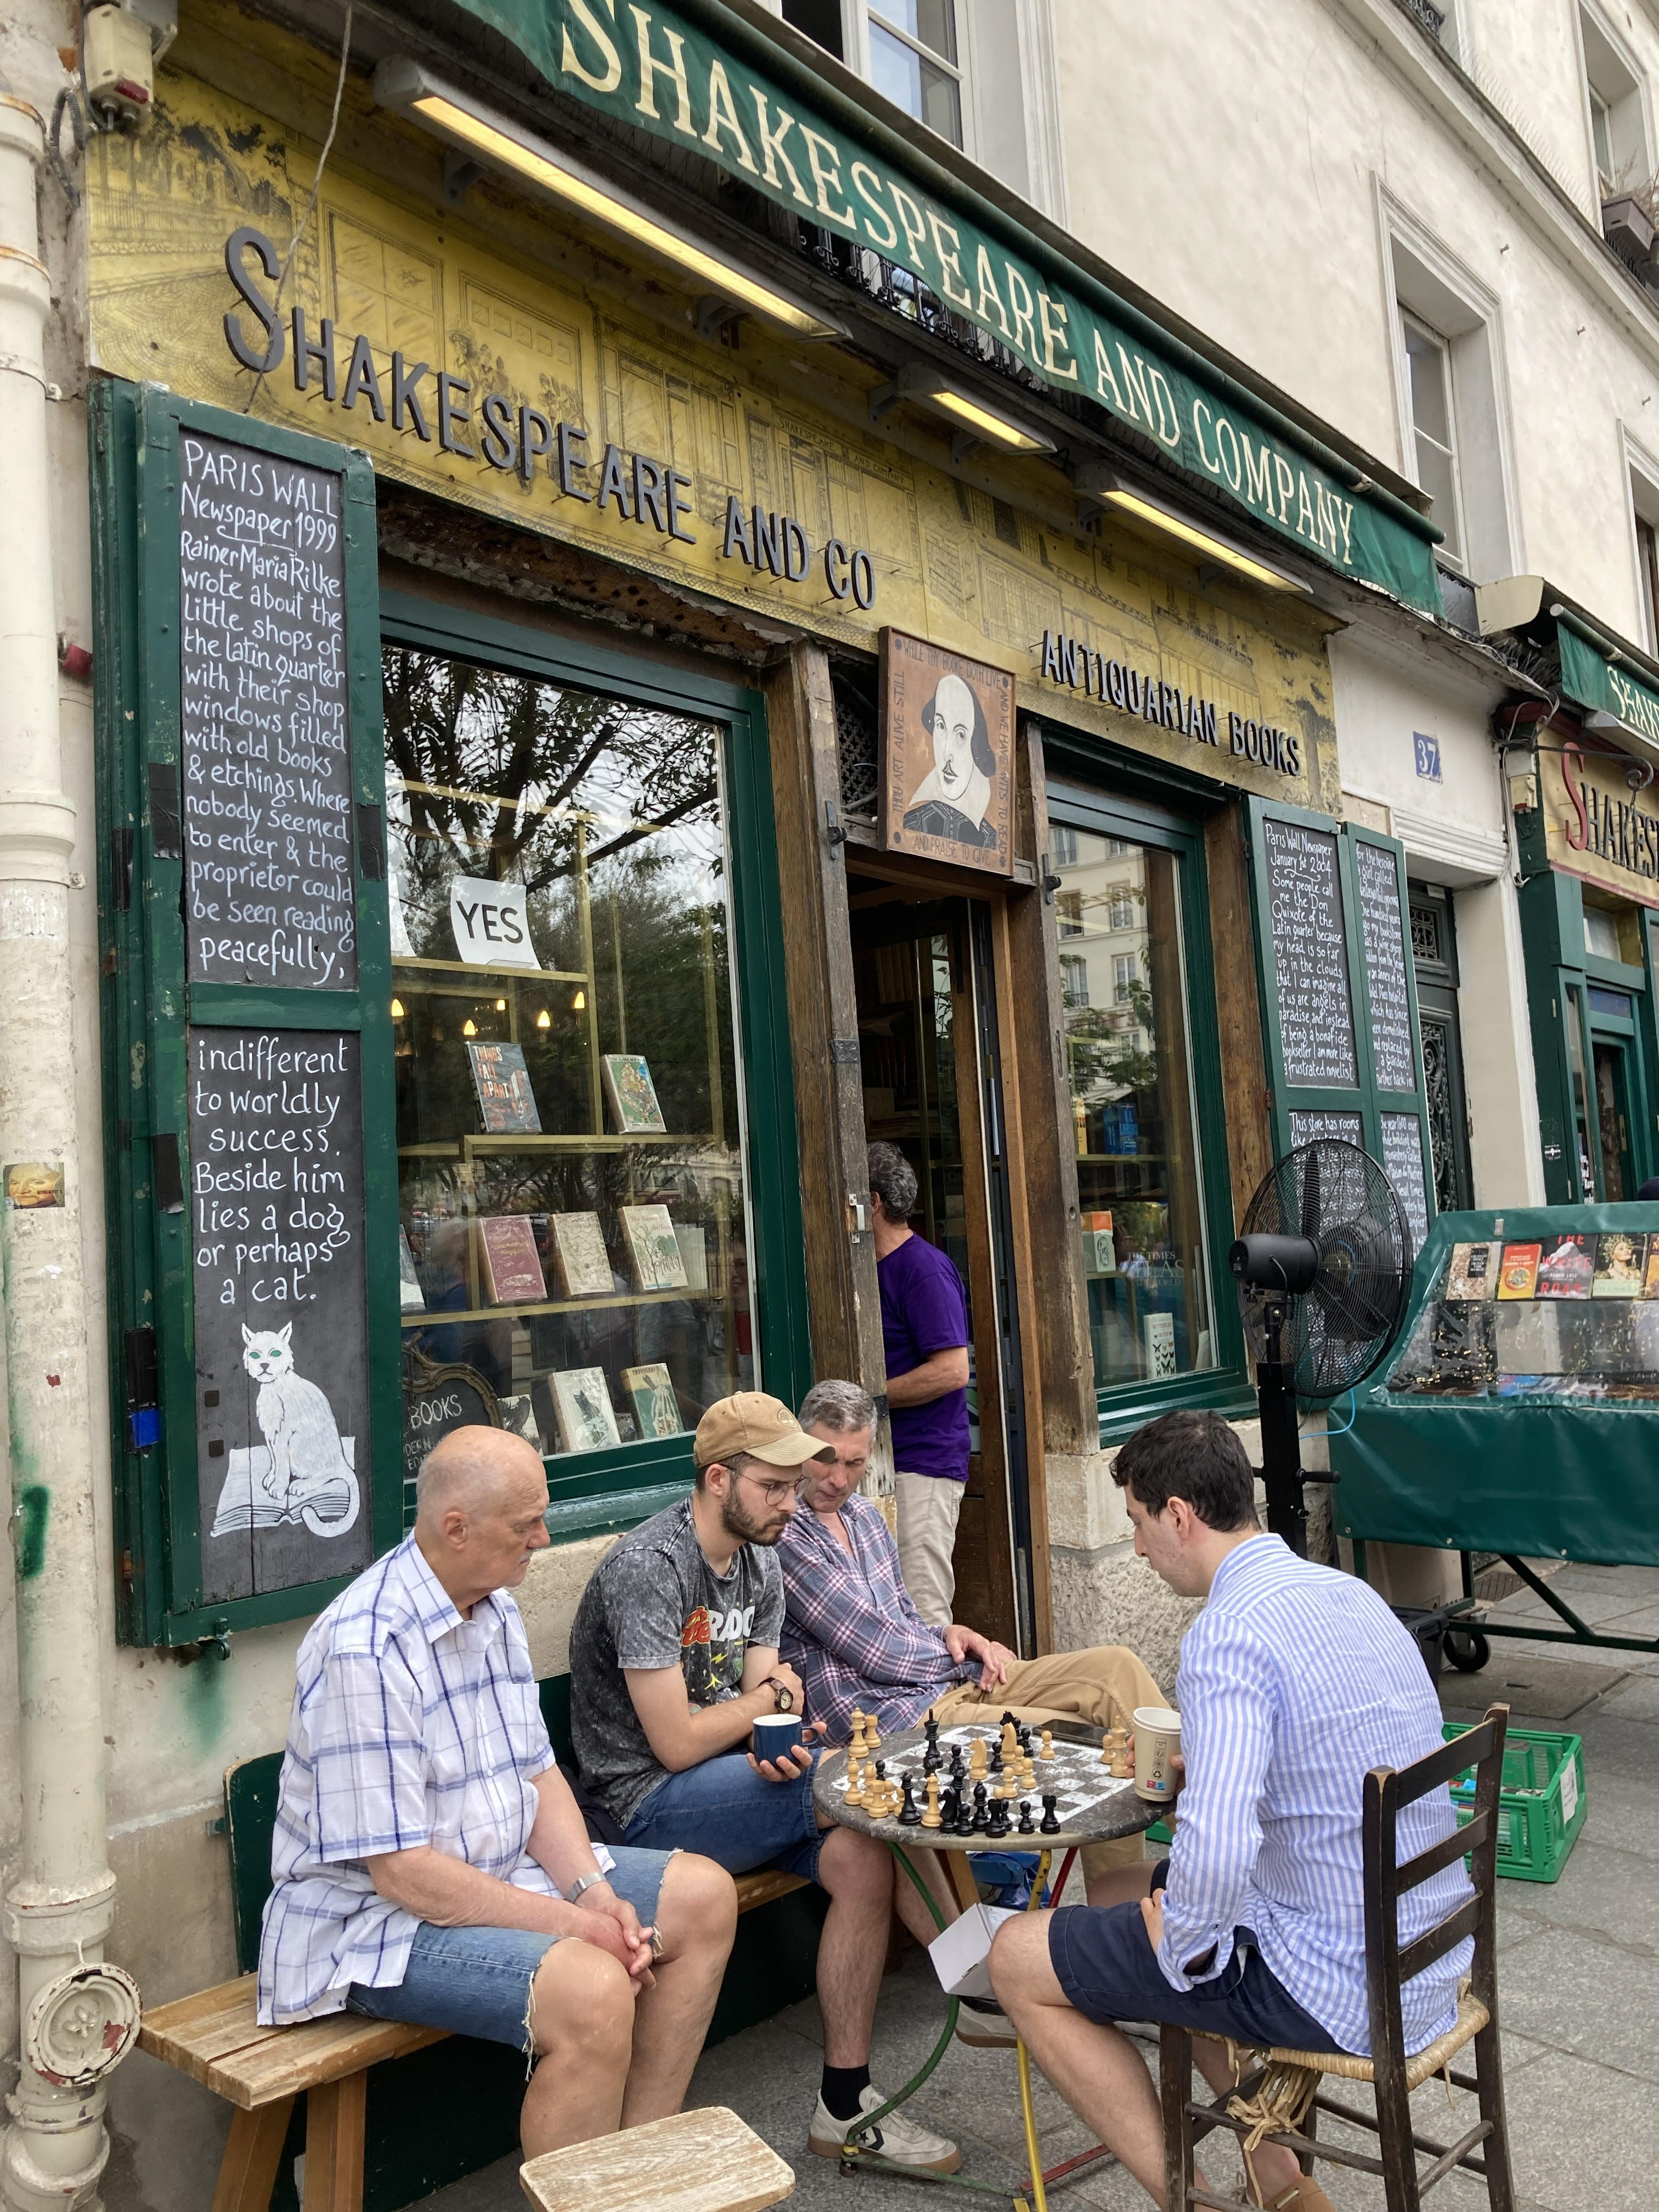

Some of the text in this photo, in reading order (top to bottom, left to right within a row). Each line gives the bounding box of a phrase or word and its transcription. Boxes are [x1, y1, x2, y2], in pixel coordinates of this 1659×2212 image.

[562, 0, 1355, 566] SHAKESPEARE AND COMPANY
[223, 227, 876, 611] SHAKESPEARE AND CO
[778, 416, 904, 484] SHAKESPEARE AND COMPANY
[185, 439, 338, 518] PARIS WALL
[182, 482, 337, 553] Newspaper 1999
[181, 531, 341, 597] Rainer Maria Rilke
[182, 567, 343, 630] wrote about the
[185, 594, 342, 669] little shops of
[184, 627, 221, 657] the
[276, 654, 345, 689] quarter
[904, 639, 1001, 689] WHILE THY BOOKE DOTH LIVE
[186, 661, 345, 730] with their shop
[1041, 630, 1300, 776] ANTIQUARIAN BOOKS
[184, 696, 347, 753] windows filled
[892, 670, 905, 814] THOU ART ALIVE STILL
[184, 723, 331, 777] with old books
[1418, 738, 1438, 775] 37
[188, 754, 351, 814] & etchings. Where
[997, 690, 1009, 854] AND WE HAVE WITS TO READ
[187, 790, 351, 844] nobody seemed
[1561, 742, 1659, 882] SHAKES
[190, 822, 348, 873] to enter & the
[914, 835, 990, 866] AND PRAISE TO GIVE
[1265, 823, 1332, 862] Paris Wall Newspaper
[1271, 847, 1332, 879] January 1st 2004
[191, 860, 354, 905] proprietor could
[1272, 869, 1334, 898] Some people call
[1280, 891, 1328, 912] me the Don
[193, 890, 355, 953] be seen reading
[457, 900, 524, 944] YES
[1272, 900, 1334, 928] Quixote of the
[1272, 918, 1342, 944] Latin quarter because
[199, 929, 345, 985] peacefully,
[1273, 938, 1339, 963] my head is so far
[1278, 957, 1342, 979] up in the clouds
[1276, 969, 1346, 998] that I can imagine all
[1278, 988, 1347, 1014] of us are angels in
[1280, 1023, 1314, 1047] of being a
[1325, 1014, 1351, 1029] instead
[199, 1035, 348, 1080] indifferent
[473, 1046, 503, 1062] THINGS
[478, 1063, 498, 1080] FALL
[1284, 1062, 1288, 1076] a
[1288, 1056, 1325, 1080] frustrated
[1313, 1043, 1316, 1059] I
[1339, 1045, 1353, 1062] like
[195, 1080, 341, 1128] to worldly
[482, 1081, 509, 1099] APART
[208, 1127, 341, 1156] success.
[1289, 1112, 1359, 1132] This store has rooms
[1352, 1134, 1356, 1145] a
[194, 1157, 345, 1194] Beside him
[200, 1197, 351, 1248] lies a dog
[197, 1233, 333, 1274] or perhaps
[1148, 1251, 1176, 1260] TIMES
[221, 1267, 317, 1305] a cat.
[408, 1395, 462, 1431] BOOKS
